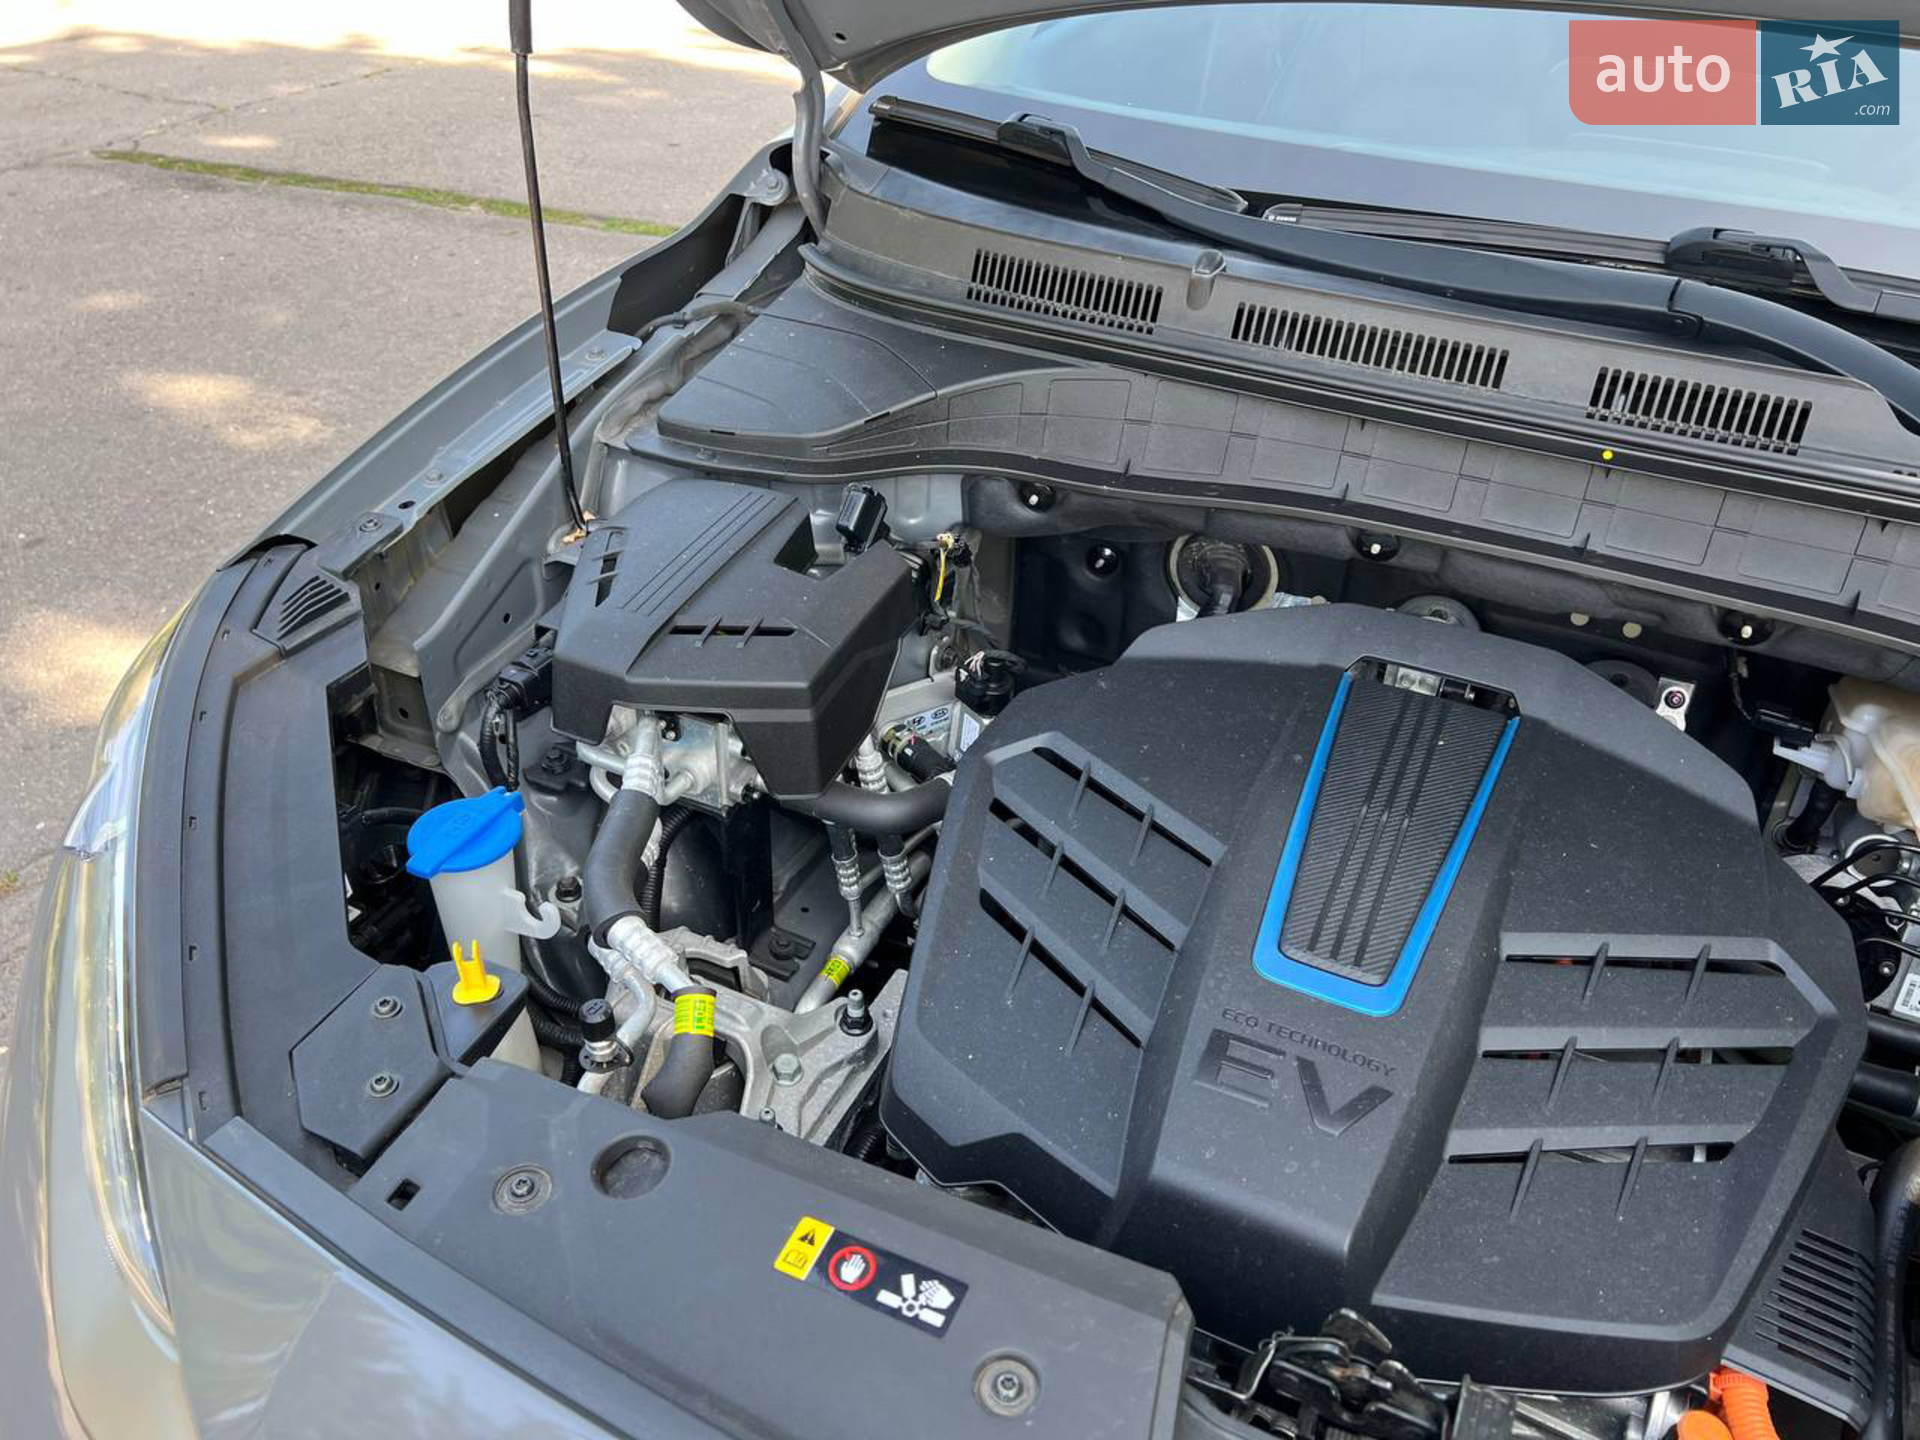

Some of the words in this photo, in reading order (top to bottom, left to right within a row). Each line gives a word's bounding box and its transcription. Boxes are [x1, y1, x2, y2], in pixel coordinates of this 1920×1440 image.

[1194, 1028, 1395, 1138] EV
[1222, 1007, 1258, 1029] ECO
[1265, 1021, 1396, 1077] TECHNOLOGY
